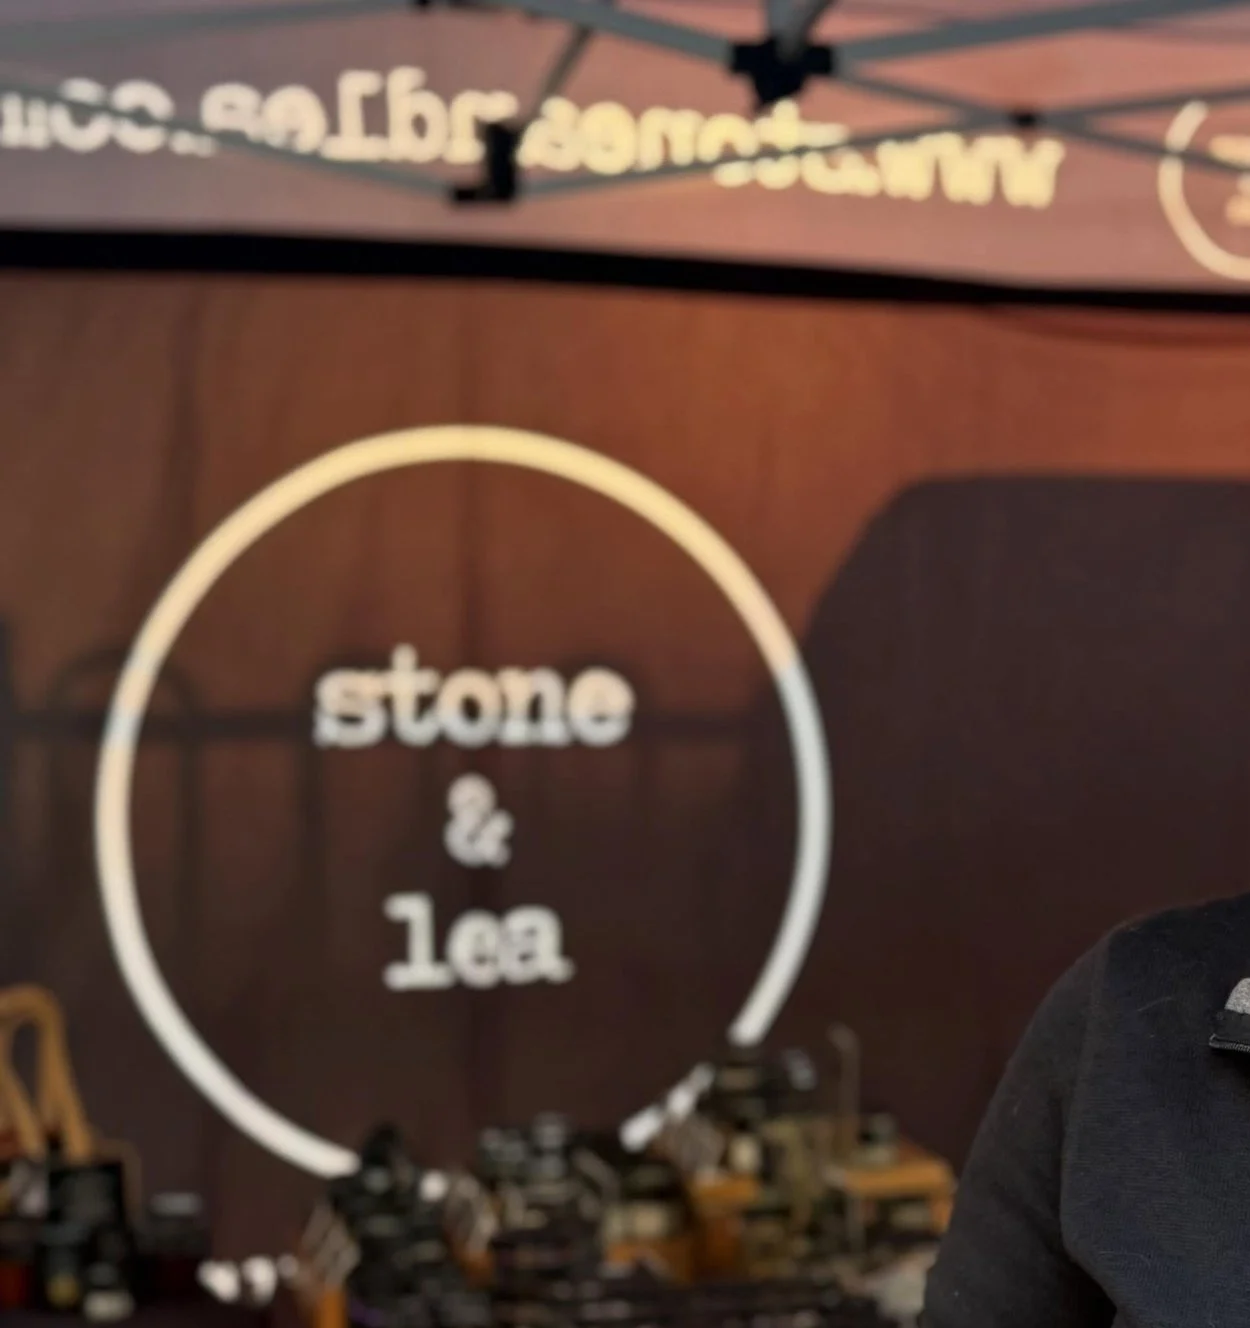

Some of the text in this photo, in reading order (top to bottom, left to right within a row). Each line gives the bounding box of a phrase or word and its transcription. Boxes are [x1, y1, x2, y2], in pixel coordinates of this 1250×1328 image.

[312, 642, 635, 749] stone
[443, 772, 514, 869] &
[383, 892, 574, 991] lea
